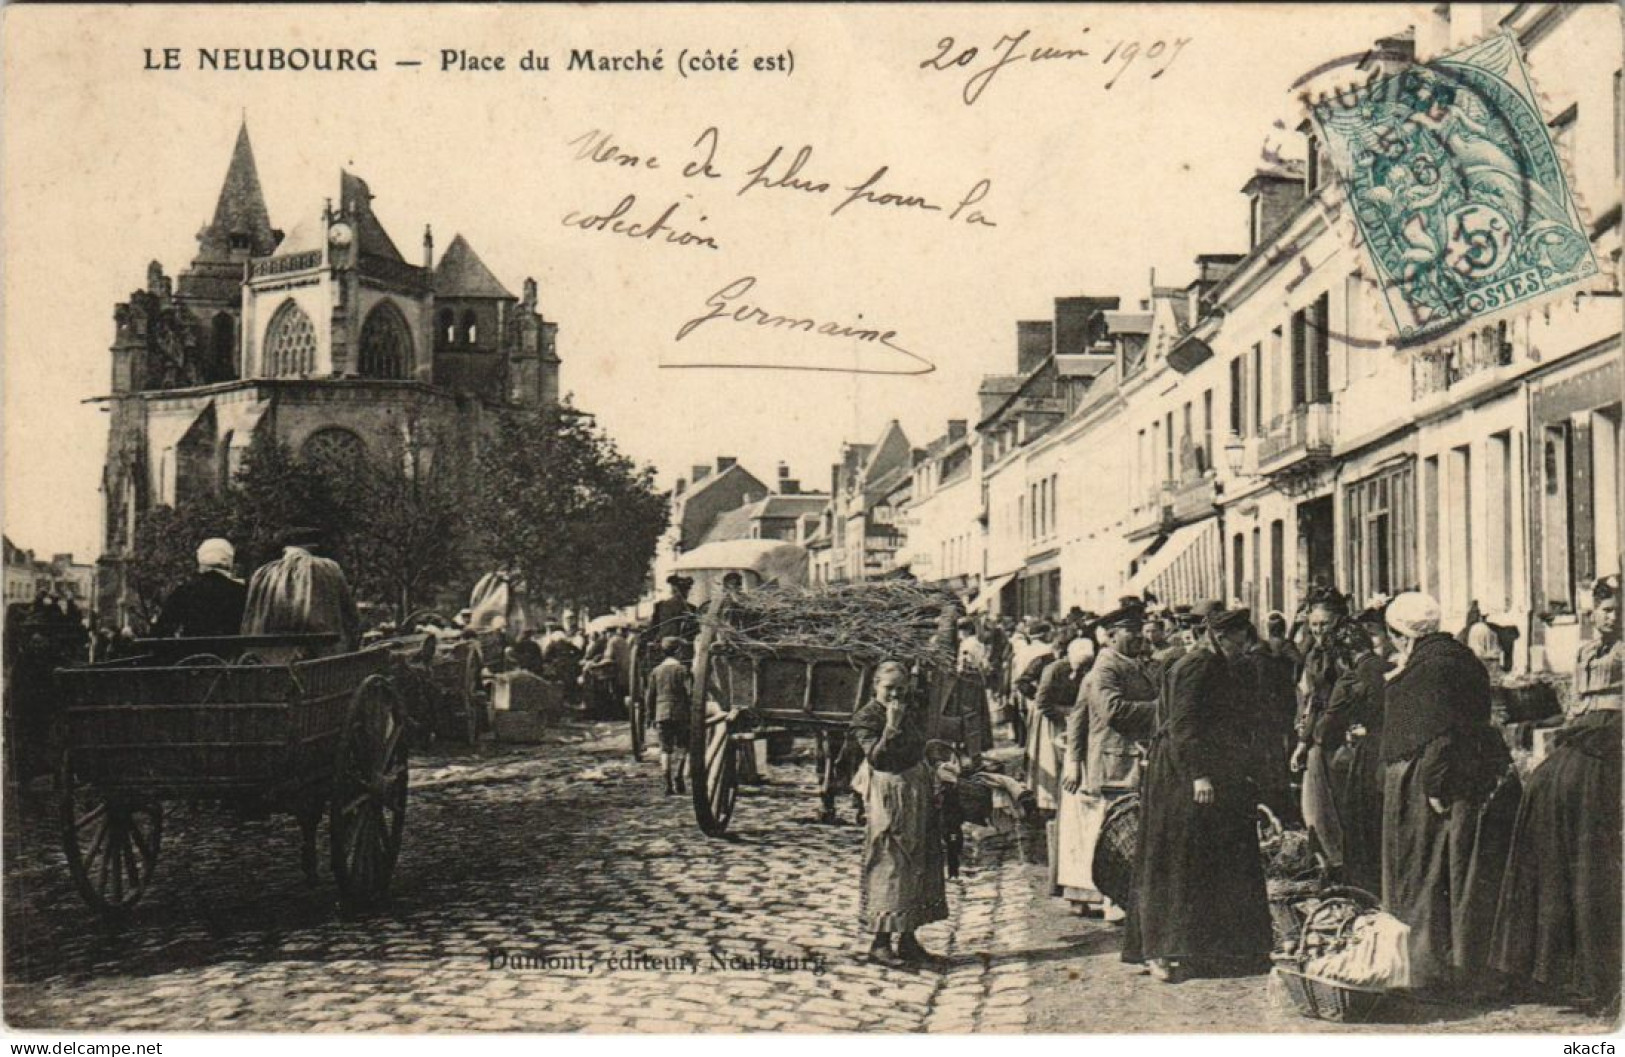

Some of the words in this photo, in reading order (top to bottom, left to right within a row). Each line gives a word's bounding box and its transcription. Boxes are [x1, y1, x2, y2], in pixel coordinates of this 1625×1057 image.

[143, 48, 181, 71] LE
[198, 48, 378, 71] NEUBOURG
[440, 49, 505, 72] Place
[519, 49, 550, 72] du
[566, 47, 665, 72] Marché
[677, 47, 740, 78] (côté
[752, 49, 796, 78] est)
[919, 35, 976, 71] 20
[964, 27, 1090, 105] Juin
[1101, 36, 1192, 90] 1907
[682, 126, 722, 178] de
[736, 144, 830, 196] plus
[832, 165, 942, 215] pour
[949, 179, 997, 227] la
[675, 276, 900, 342] Germaine
[488, 948, 597, 974] Dumont,
[606, 948, 699, 974] éditeur,
[710, 949, 828, 976] Neubourg
